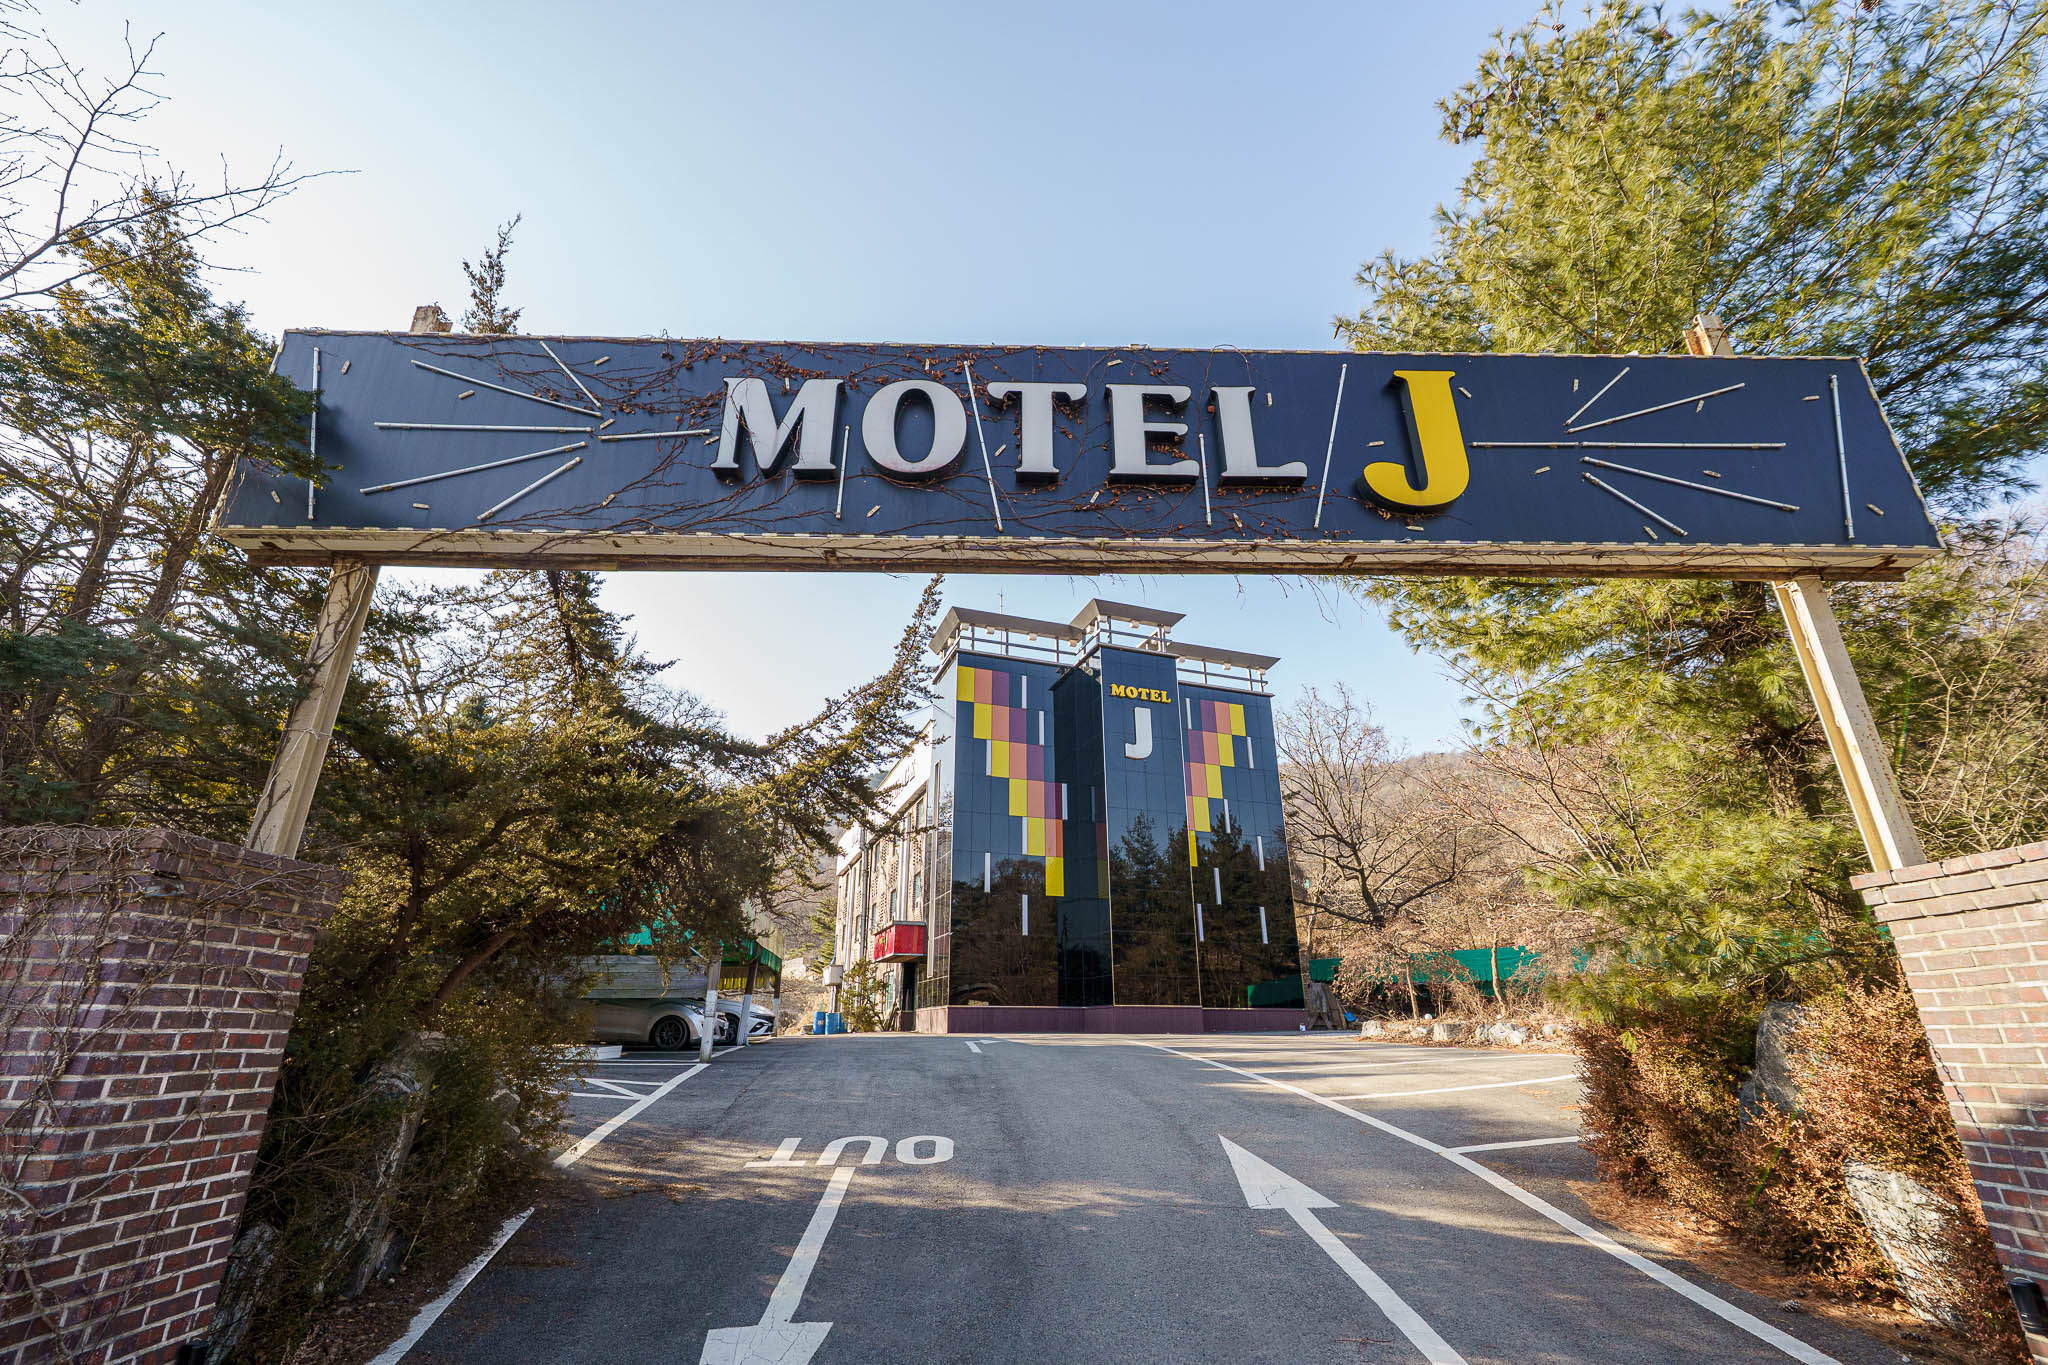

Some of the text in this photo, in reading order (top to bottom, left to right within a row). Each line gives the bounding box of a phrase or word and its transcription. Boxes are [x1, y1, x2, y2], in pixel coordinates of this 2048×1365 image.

[710, 370, 1470, 507] MOTEL J
[1110, 683, 1171, 703] MOTEL
[1125, 706, 1153, 759] J
[743, 1135, 954, 1168] OUT
